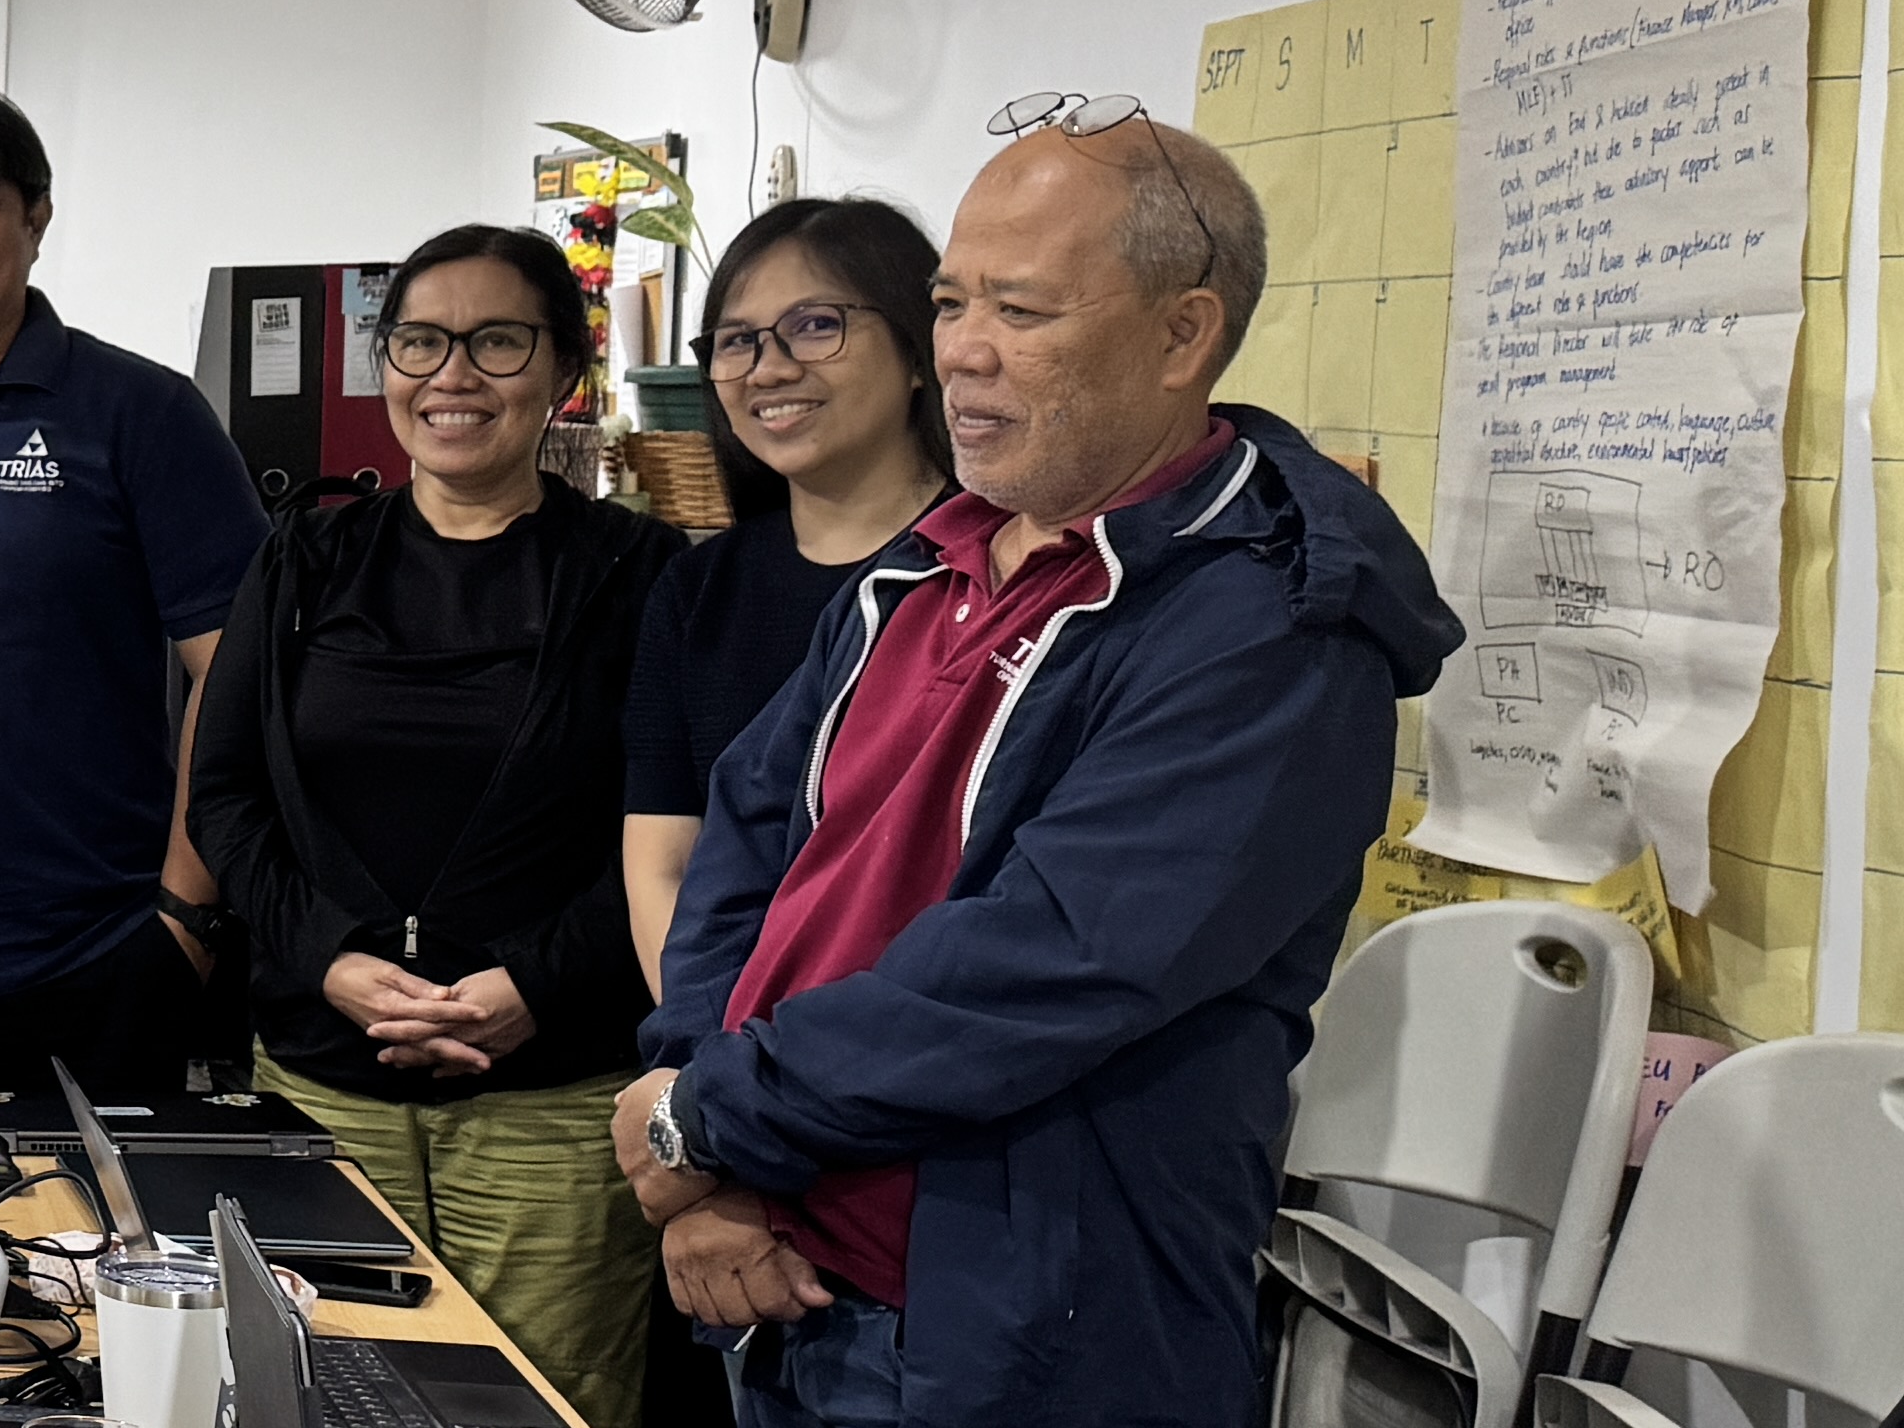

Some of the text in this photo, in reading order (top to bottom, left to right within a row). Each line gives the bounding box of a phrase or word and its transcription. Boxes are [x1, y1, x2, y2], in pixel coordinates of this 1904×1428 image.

[1201, 18, 1434, 93] SEPT S M T
[1734, 144, 1754, 163] can
[1600, 247, 1624, 272] have
[1498, 329, 1540, 369] Regional
